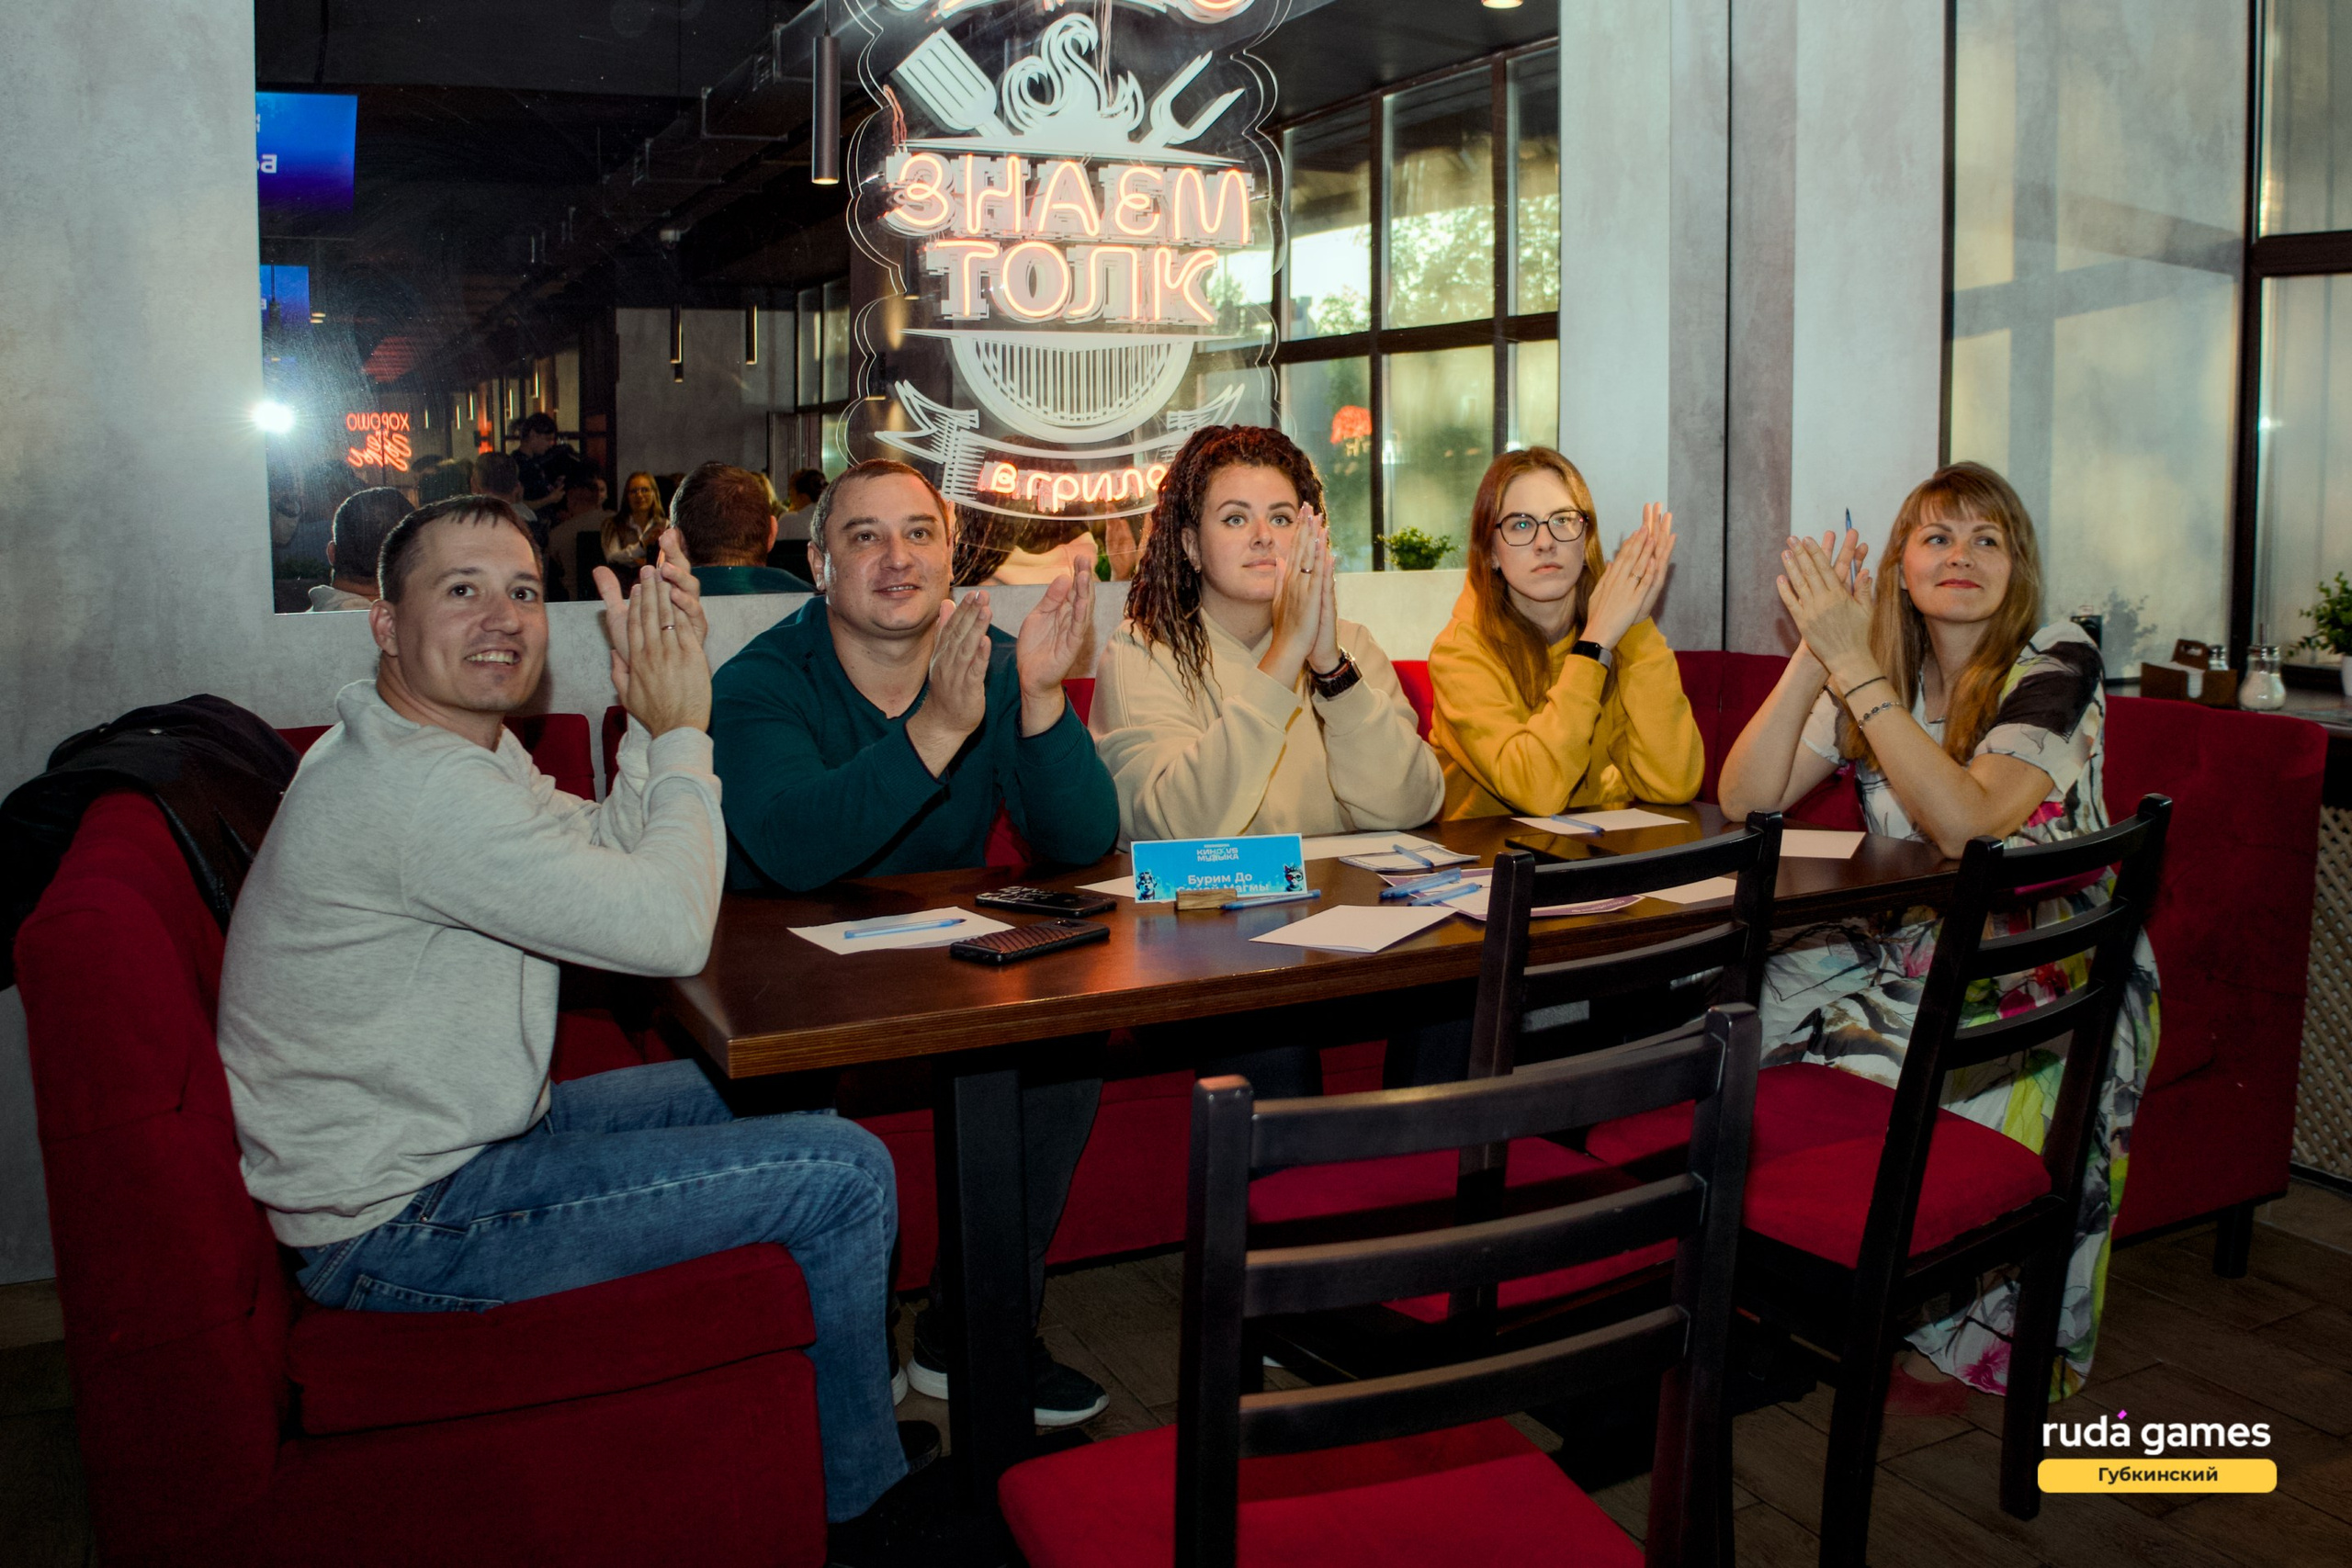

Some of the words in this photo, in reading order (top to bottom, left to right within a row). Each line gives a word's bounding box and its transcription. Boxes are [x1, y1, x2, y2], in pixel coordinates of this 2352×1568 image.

[880, 152, 1255, 247] ЗНАЕМ
[923, 240, 1219, 325] ТОЛК
[1188, 874, 1231, 887] Бурим
[1235, 872, 1253, 884] До
